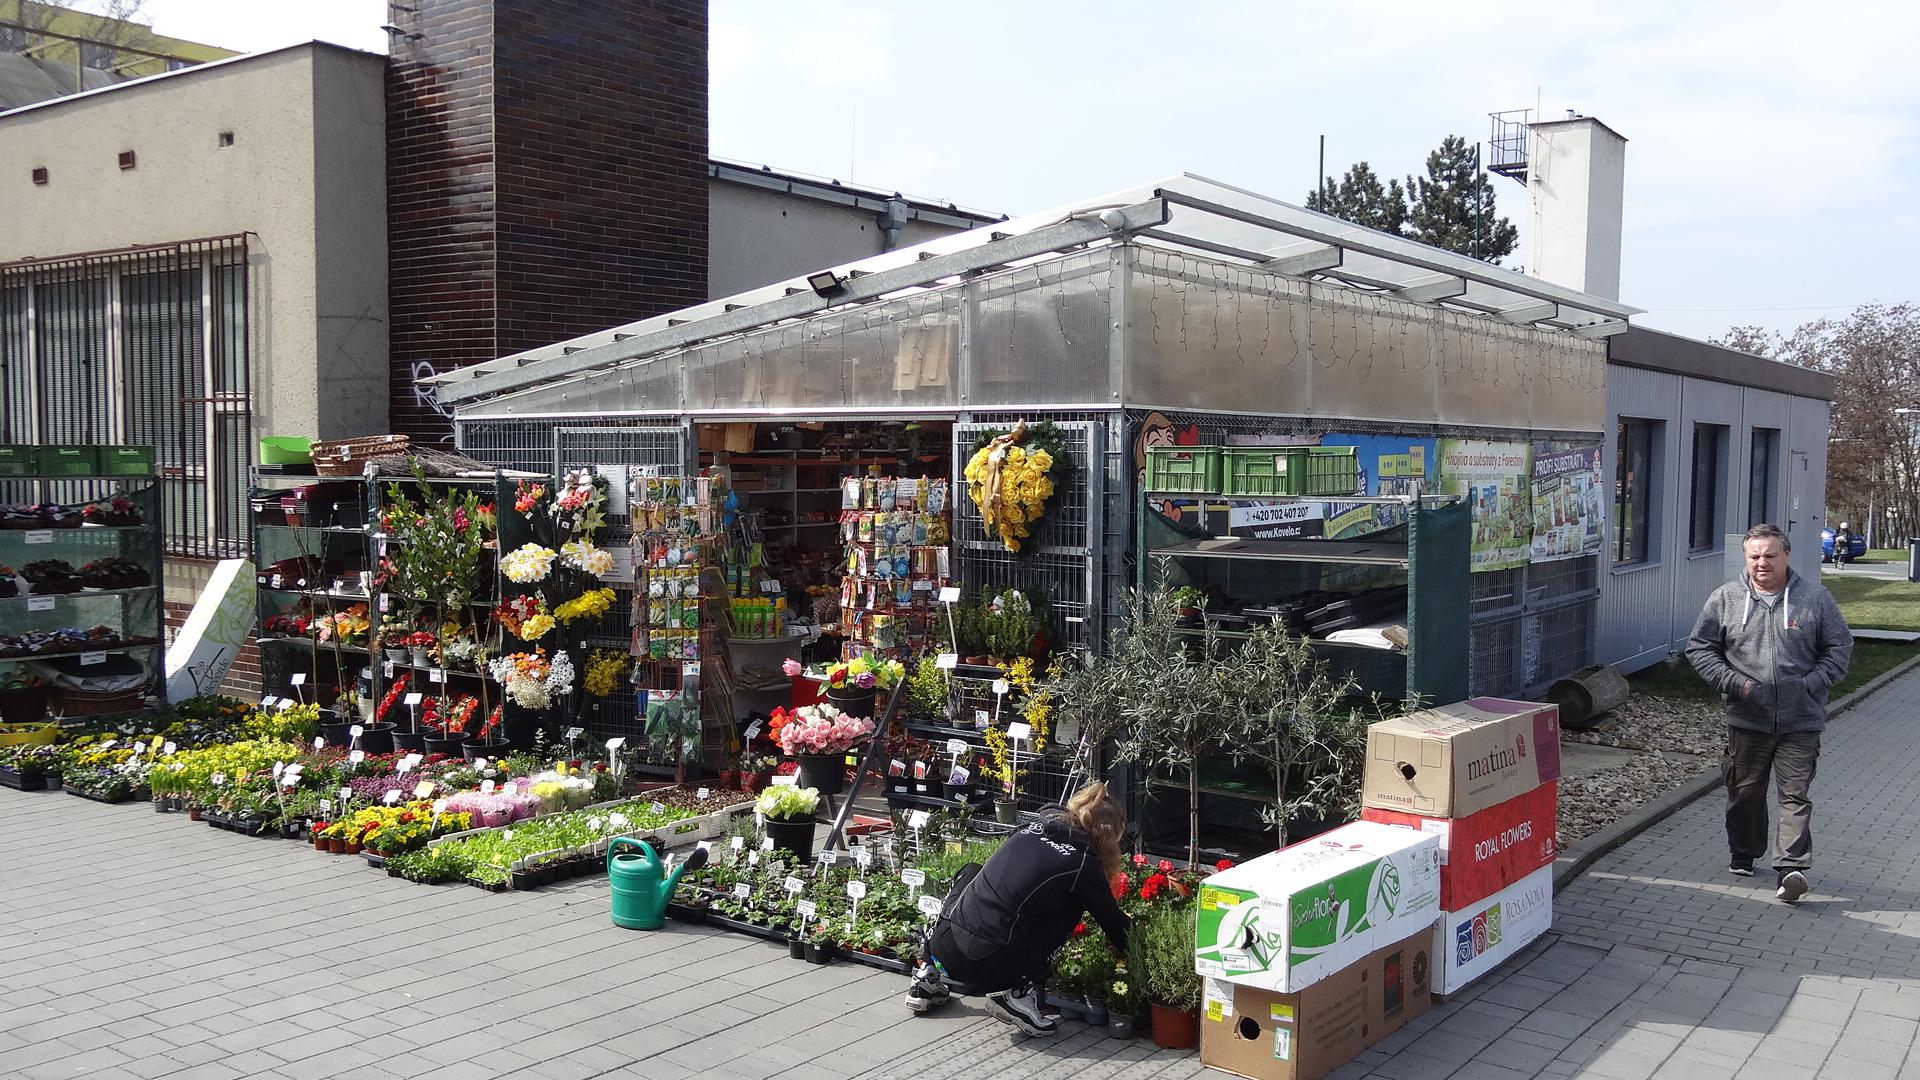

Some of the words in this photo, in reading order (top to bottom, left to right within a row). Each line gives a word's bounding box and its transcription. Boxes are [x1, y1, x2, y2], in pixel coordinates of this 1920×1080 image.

[1446, 451, 1468, 470] Hnojiva
[1473, 451, 1498, 471] substráty
[1502, 452, 1525, 471] Forestiny
[1535, 460, 1553, 477] PROFI
[1554, 451, 1584, 473] SUBSTRÁTY
[1252, 509, 1269, 522] +420
[1270, 508, 1283, 520] 702
[1284, 507, 1296, 519] 407
[1298, 506, 1309, 518] 207
[1254, 525, 1301, 539] www.Kovelo.cz
[1467, 745, 1517, 781] matina
[1377, 793, 1406, 803] matina
[1475, 835, 1500, 862] ROYAL
[1501, 820, 1532, 851] FLOWERS
